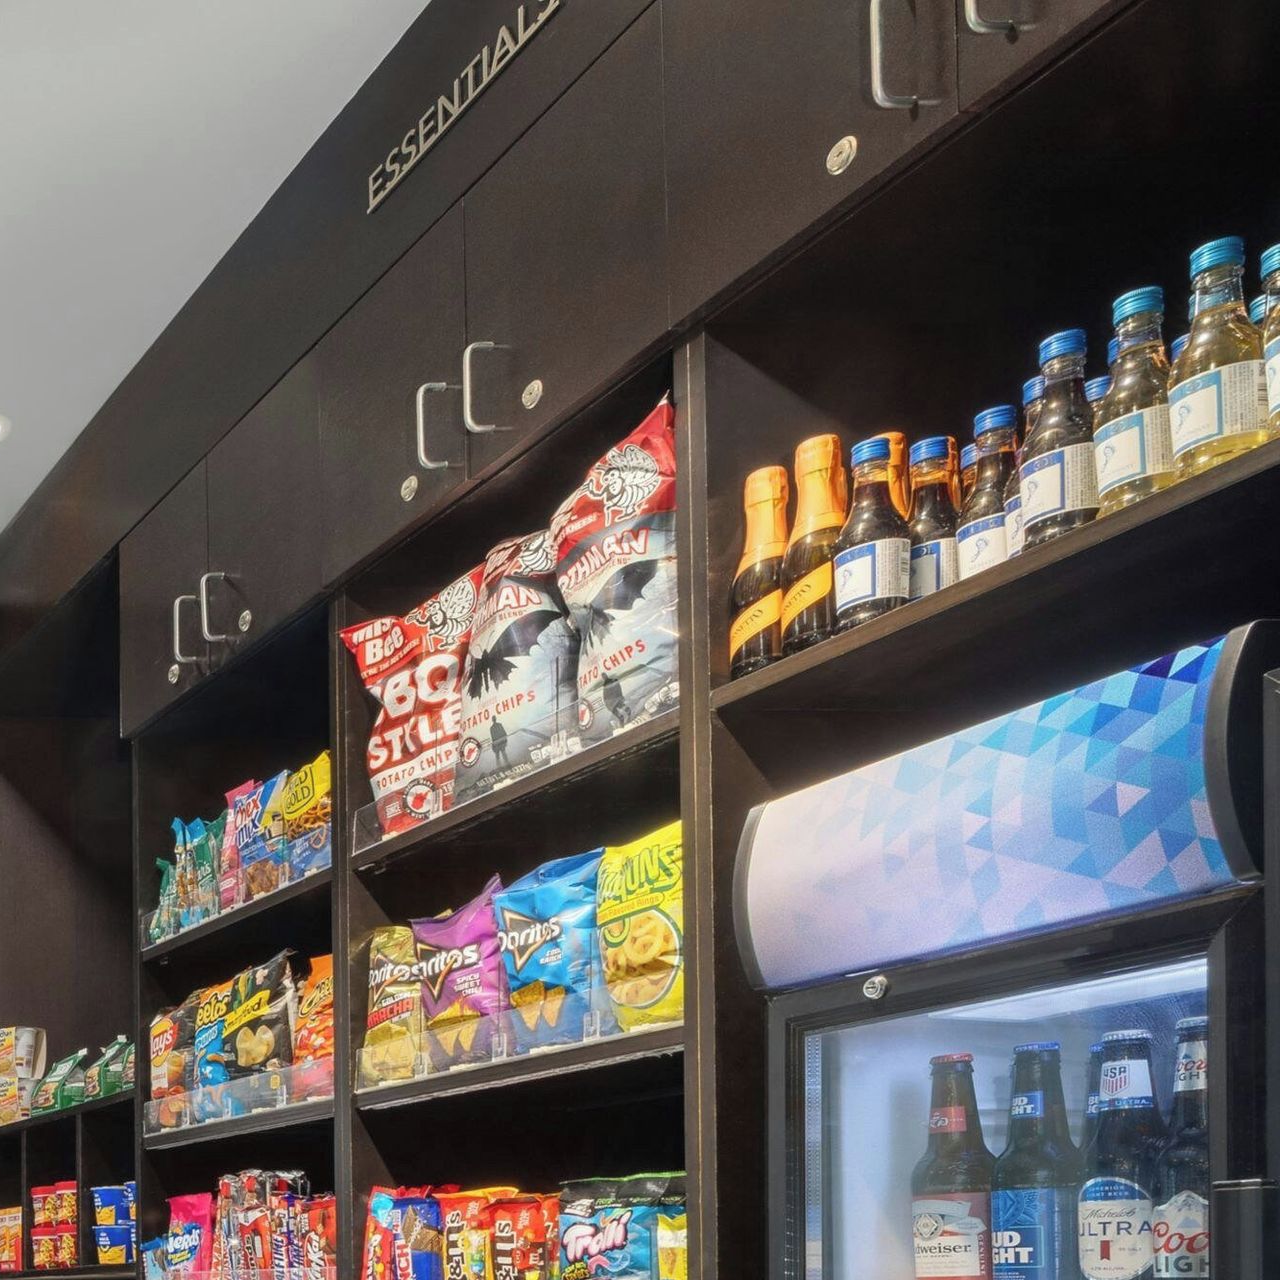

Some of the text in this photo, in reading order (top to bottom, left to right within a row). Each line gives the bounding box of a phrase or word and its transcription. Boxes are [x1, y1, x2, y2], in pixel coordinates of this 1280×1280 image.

[603, 639, 647, 671] CHIPS
[380, 654, 461, 719] BQ
[496, 690, 536, 715] CHIPS
[1082, 1207, 1138, 1219] Michelob
